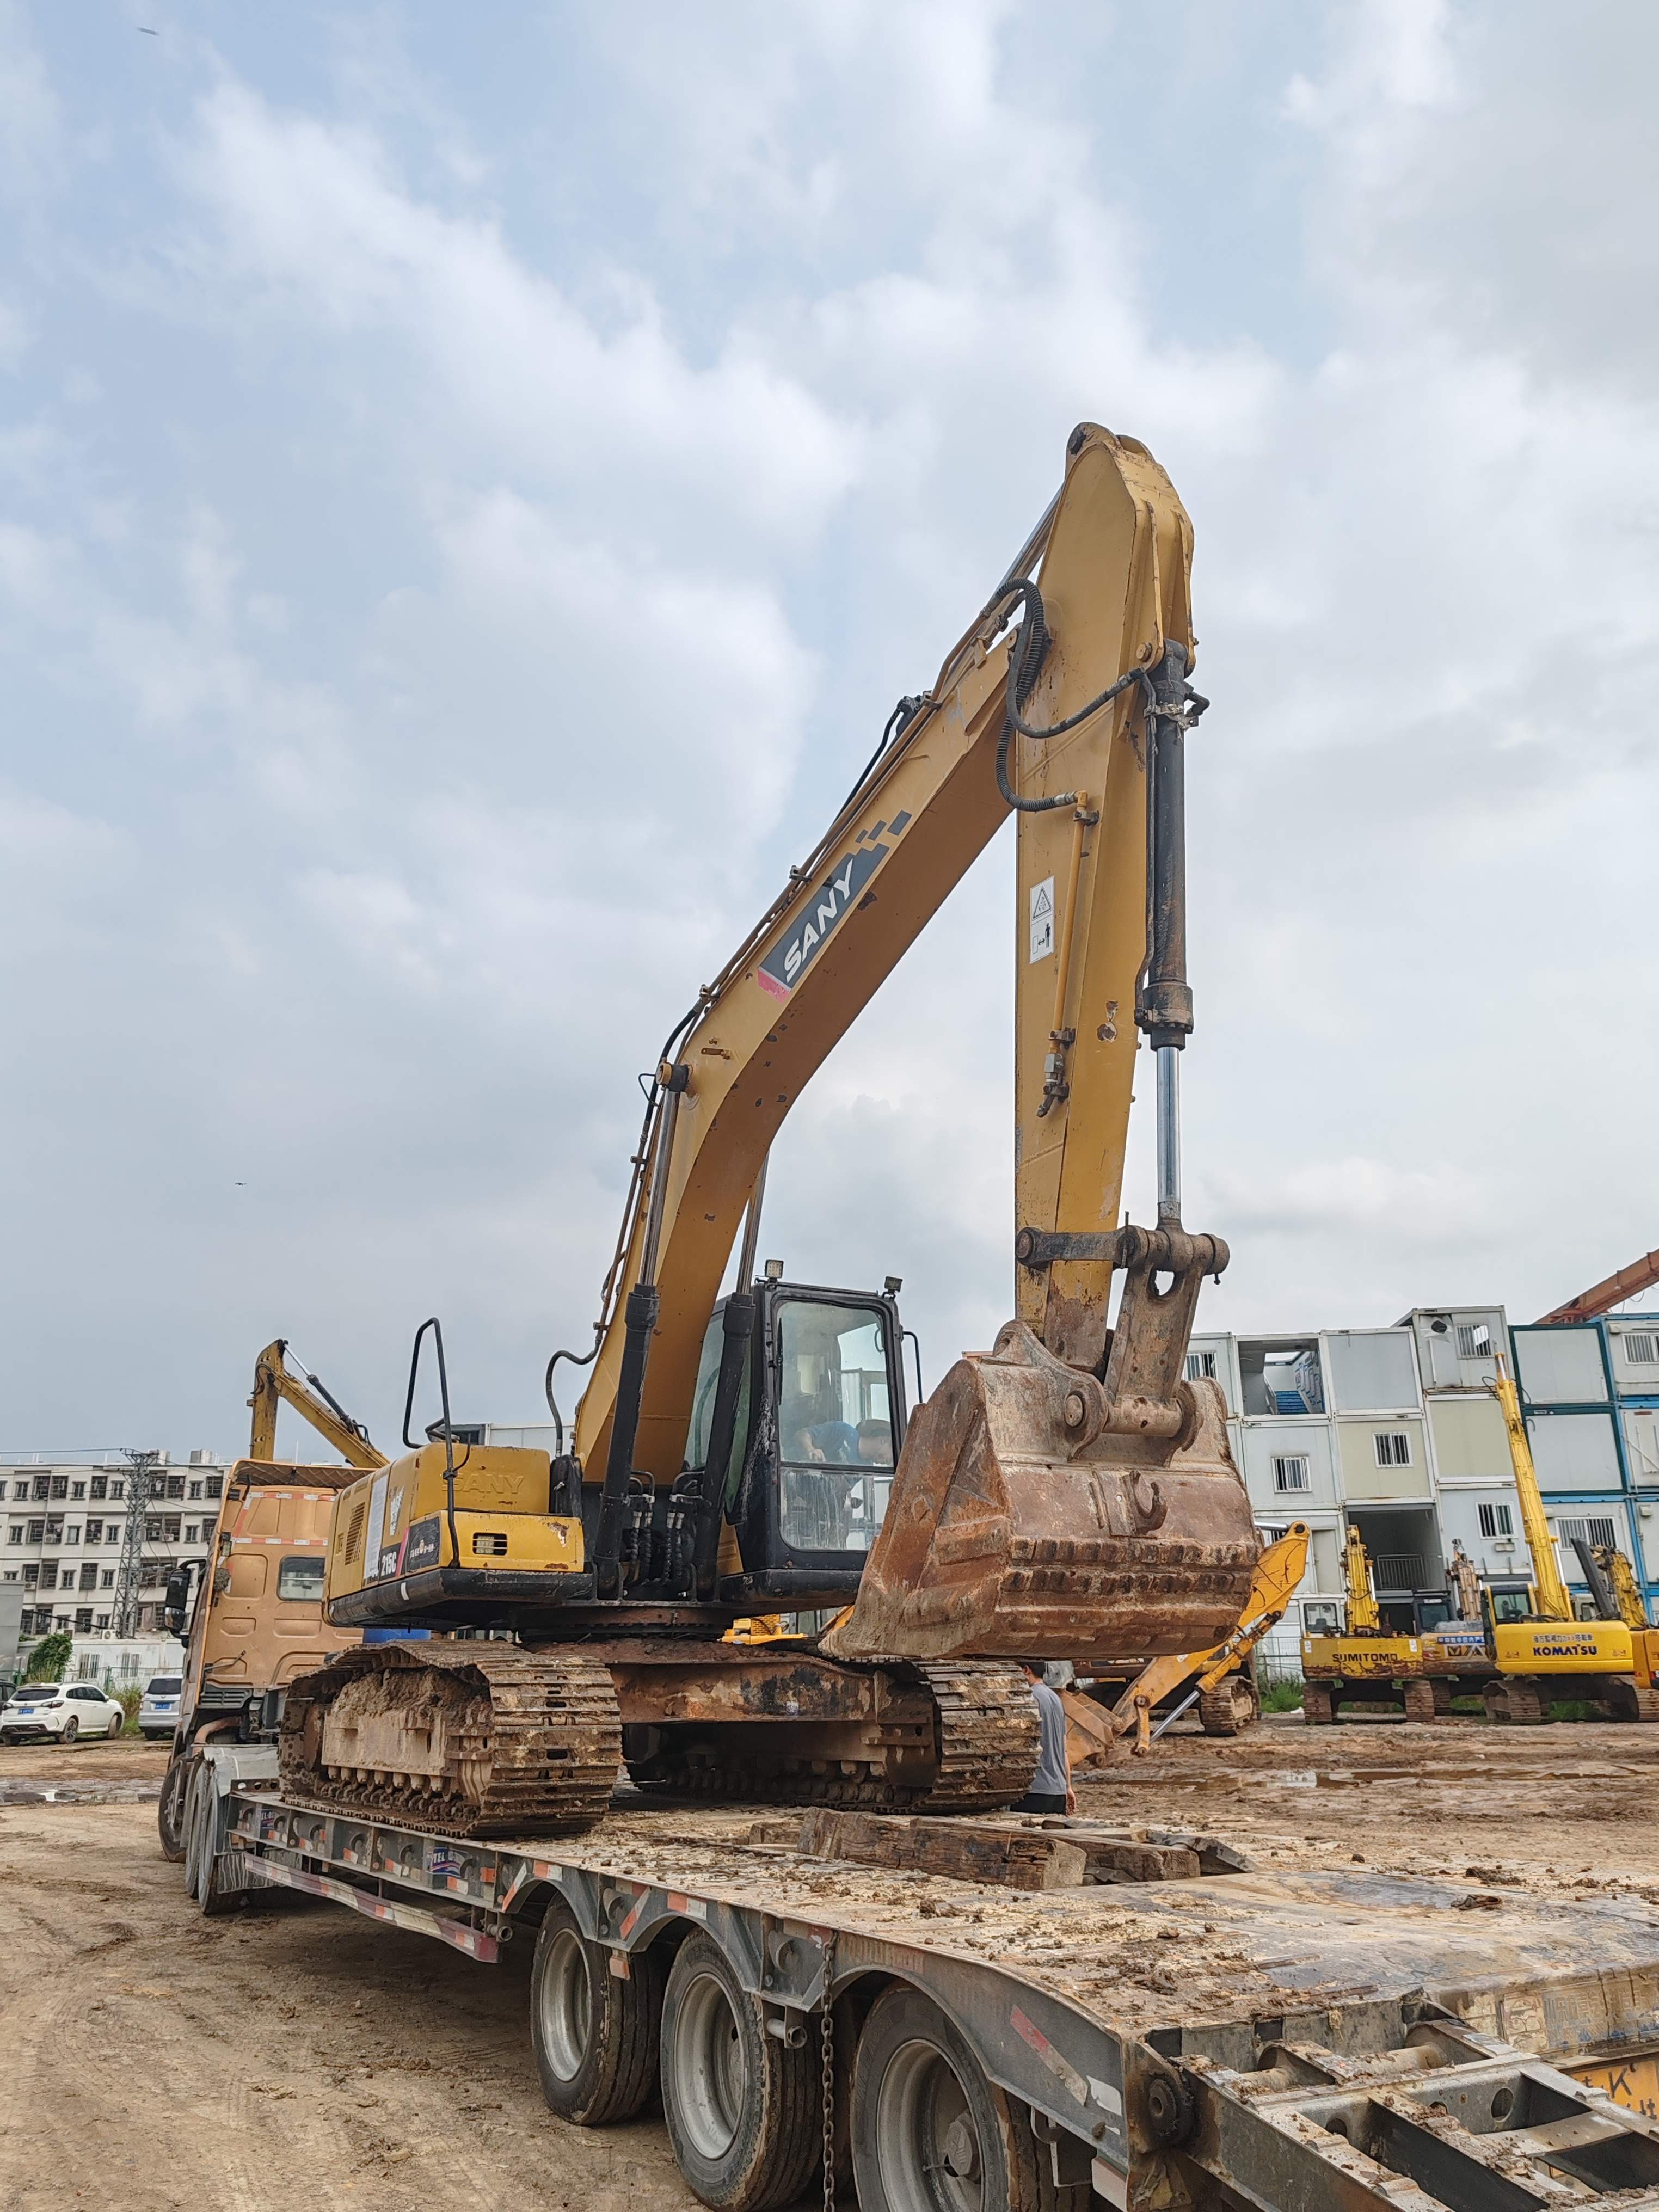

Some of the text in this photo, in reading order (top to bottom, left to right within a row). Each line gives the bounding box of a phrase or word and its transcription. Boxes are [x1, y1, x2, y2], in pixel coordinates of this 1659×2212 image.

[784, 858, 853, 983] SANY
[442, 1472, 525, 1494] SANY
[381, 1552, 397, 1576] 215C
[1332, 1653, 1397, 1662] SUMITOMO
[1533, 1645, 1597, 1656] KOMATSU
